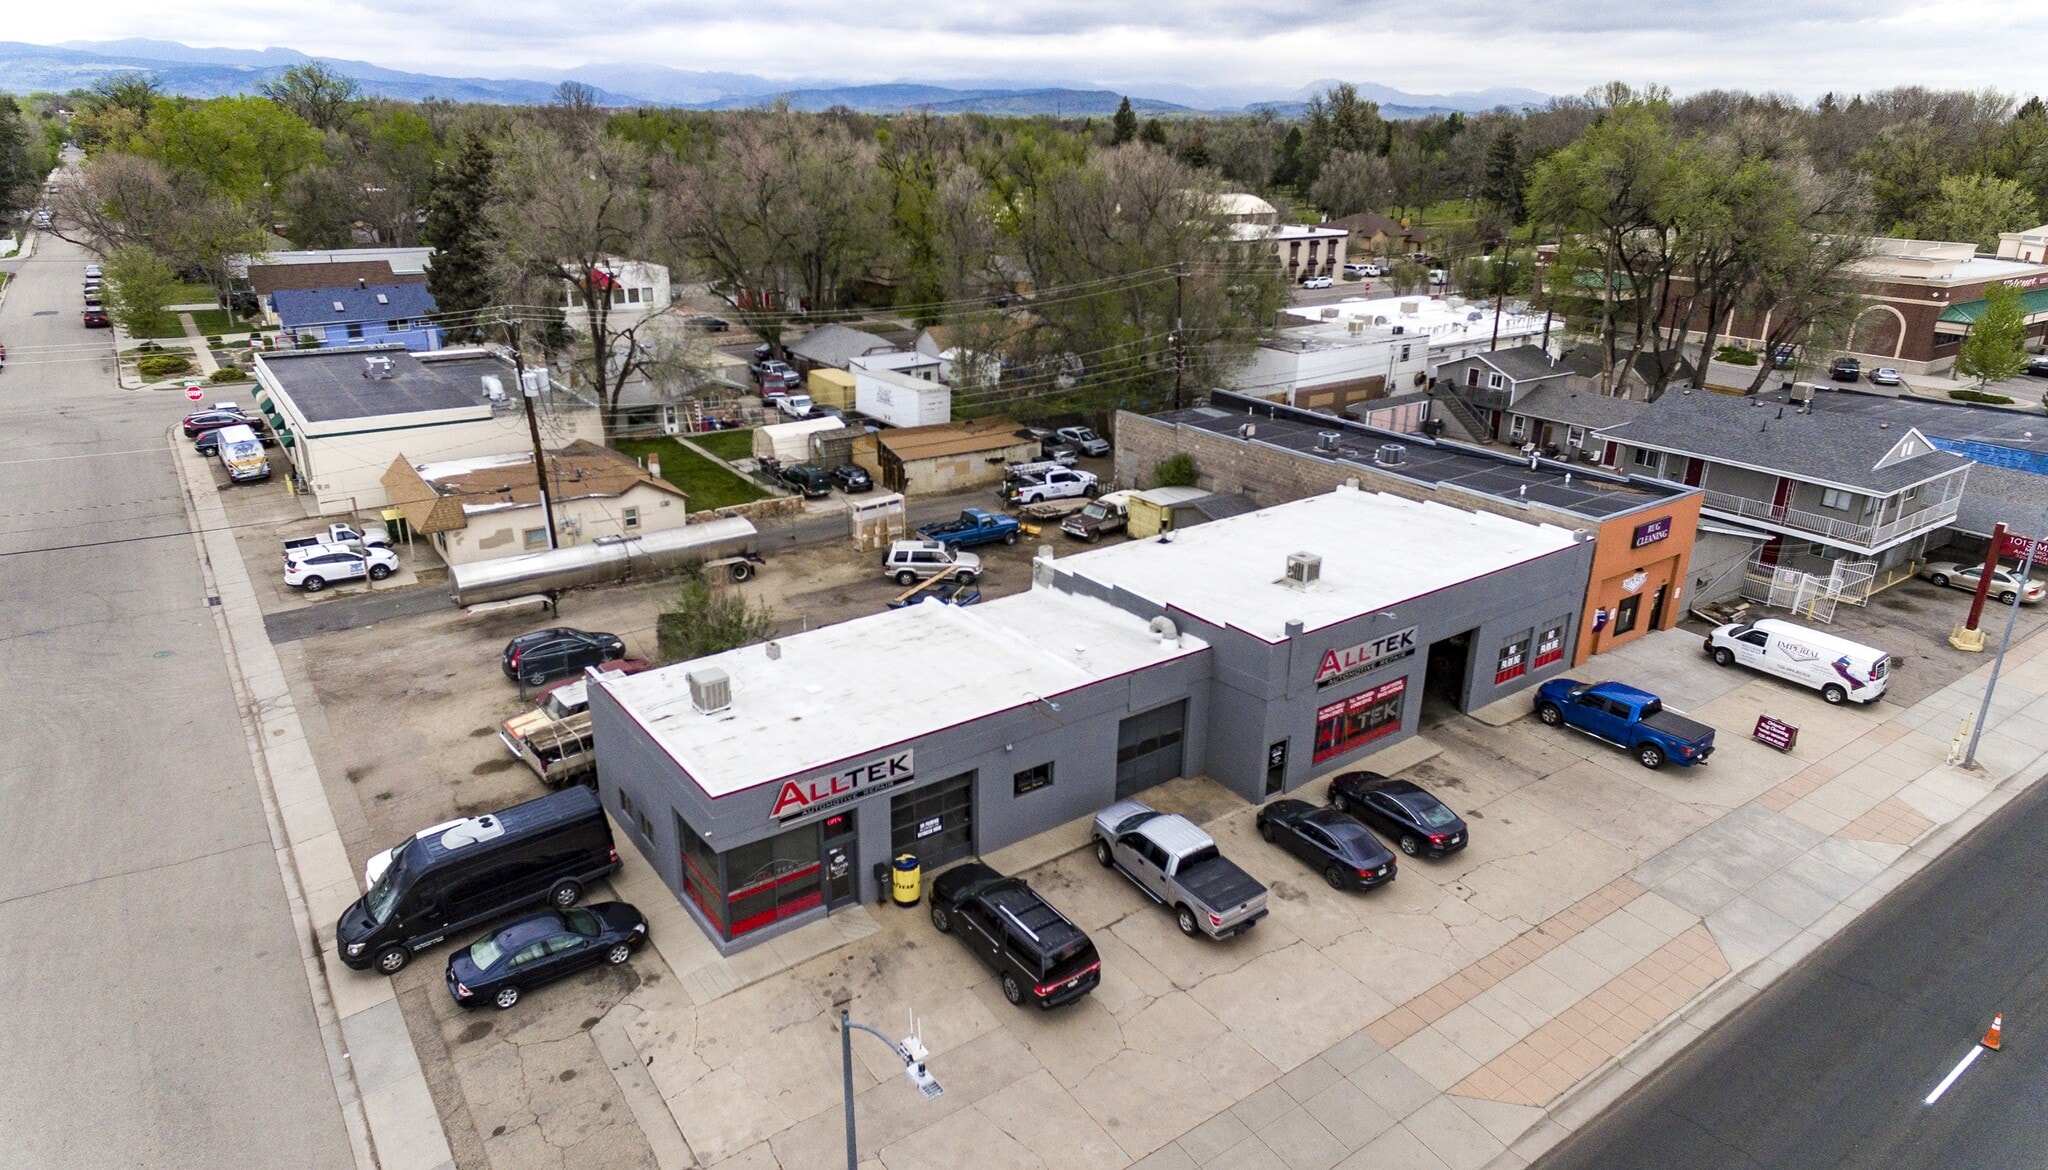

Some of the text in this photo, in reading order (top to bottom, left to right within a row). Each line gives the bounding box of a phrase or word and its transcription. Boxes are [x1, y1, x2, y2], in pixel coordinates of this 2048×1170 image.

[1636, 529, 1668, 546] CLEANING
[1647, 522, 1661, 533] RUG
[1317, 630, 1414, 680] ALLTEK
[1777, 640, 1819, 659] IMPERIAL
[1328, 663, 1376, 685] AUTOMOTIVE
[772, 754, 909, 816] ALLTEK
[802, 780, 894, 816] AUTOMOTIVE REPAIR
[827, 816, 842, 826] OPEN
